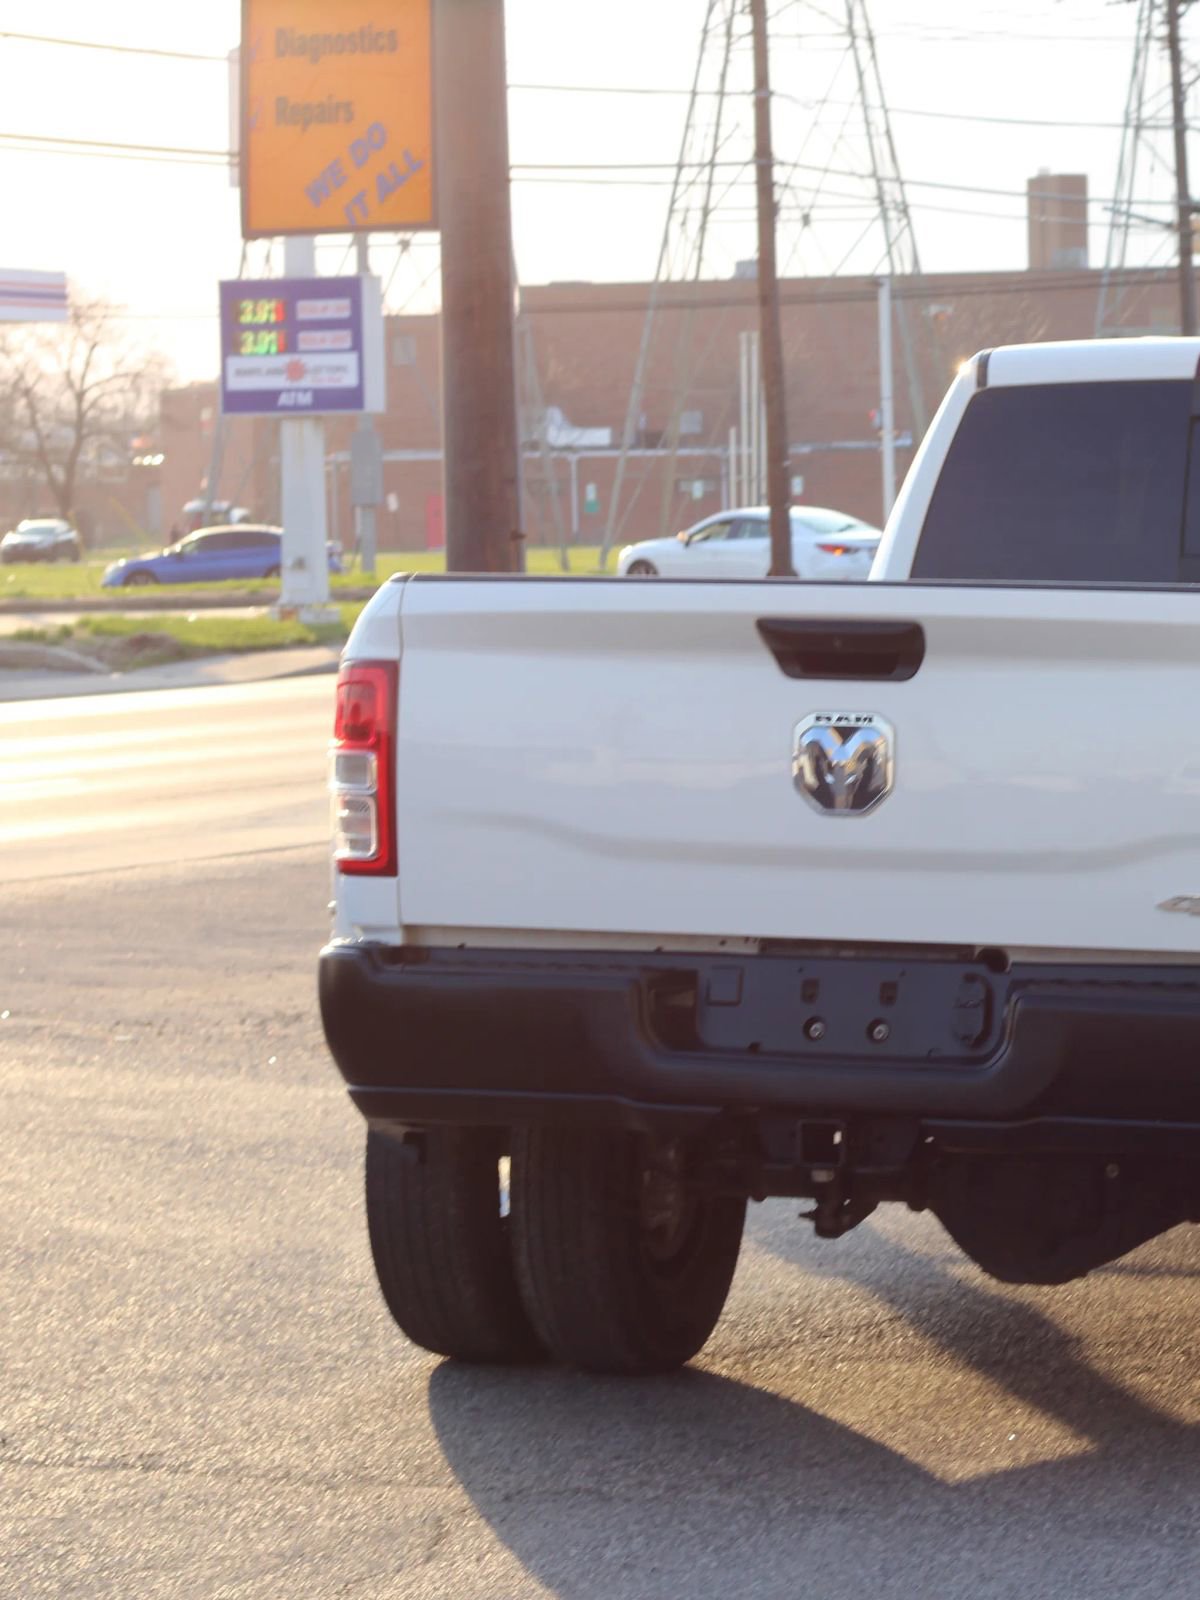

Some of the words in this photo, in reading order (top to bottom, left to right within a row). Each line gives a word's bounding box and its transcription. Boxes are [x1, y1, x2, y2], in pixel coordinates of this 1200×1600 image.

[274, 23, 399, 64] Diagnostics
[274, 94, 355, 133] Repairs
[304, 156, 348, 208] WE
[349, 121, 388, 169] DO
[343, 190, 370, 225] IT
[376, 148, 425, 204] ALL
[815, 714, 874, 724] RAM
